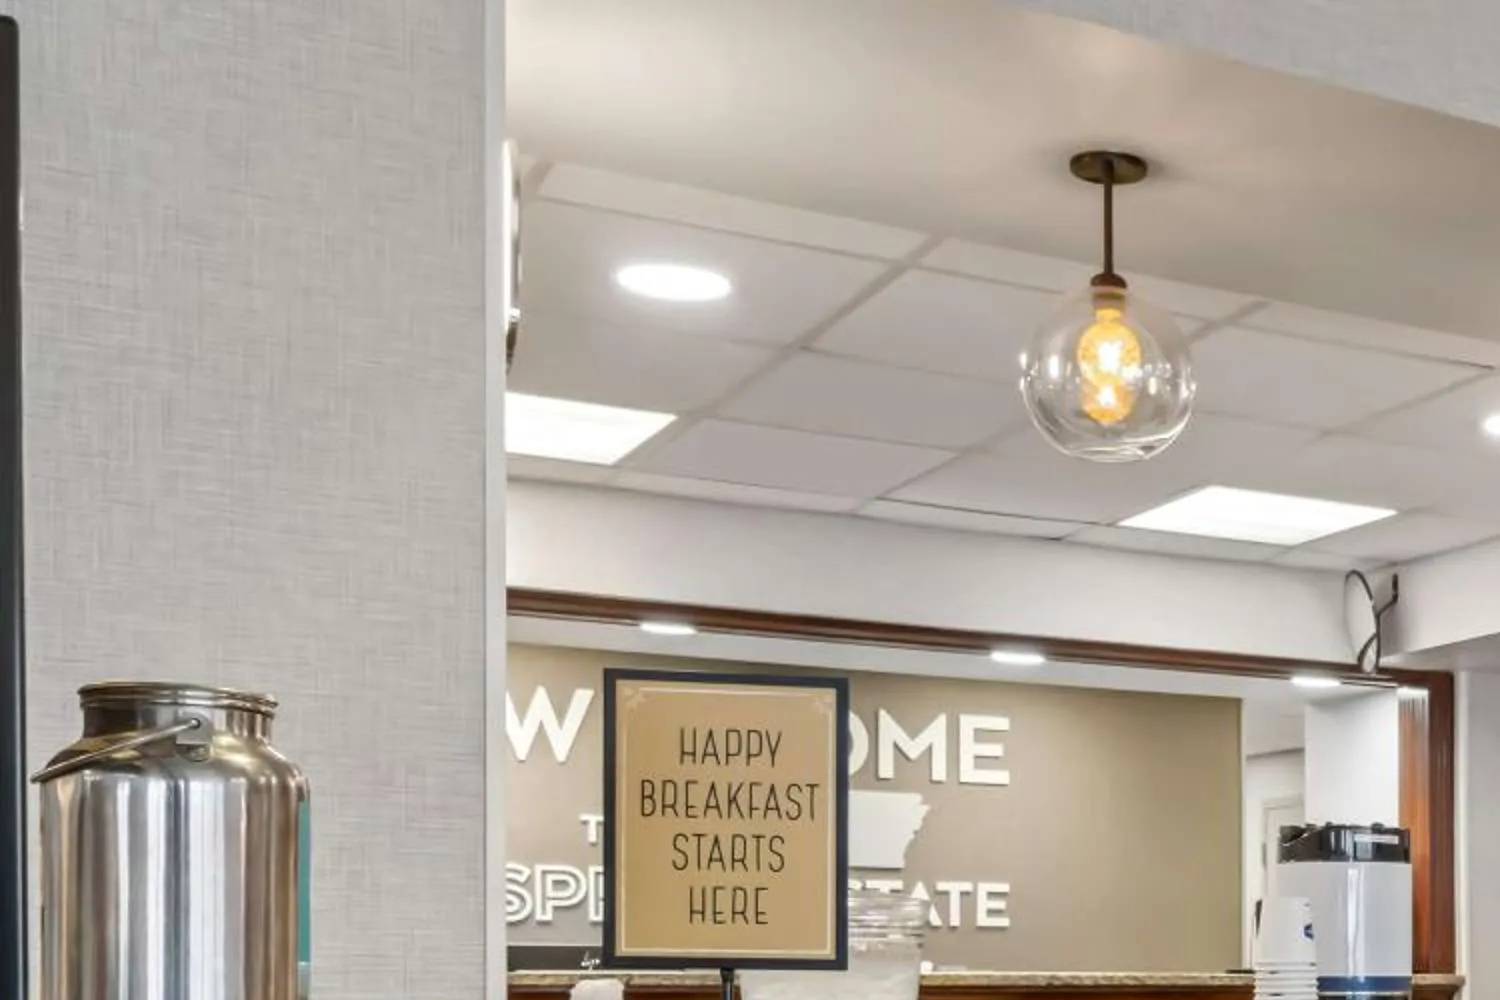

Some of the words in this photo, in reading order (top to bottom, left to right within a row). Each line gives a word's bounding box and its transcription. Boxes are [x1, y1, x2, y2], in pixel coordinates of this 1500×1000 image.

[679, 727, 783, 768] HAPPY
[640, 779, 821, 821] BREAKFAST
[671, 832, 785, 873] STARTS
[689, 885, 769, 925] HERE
